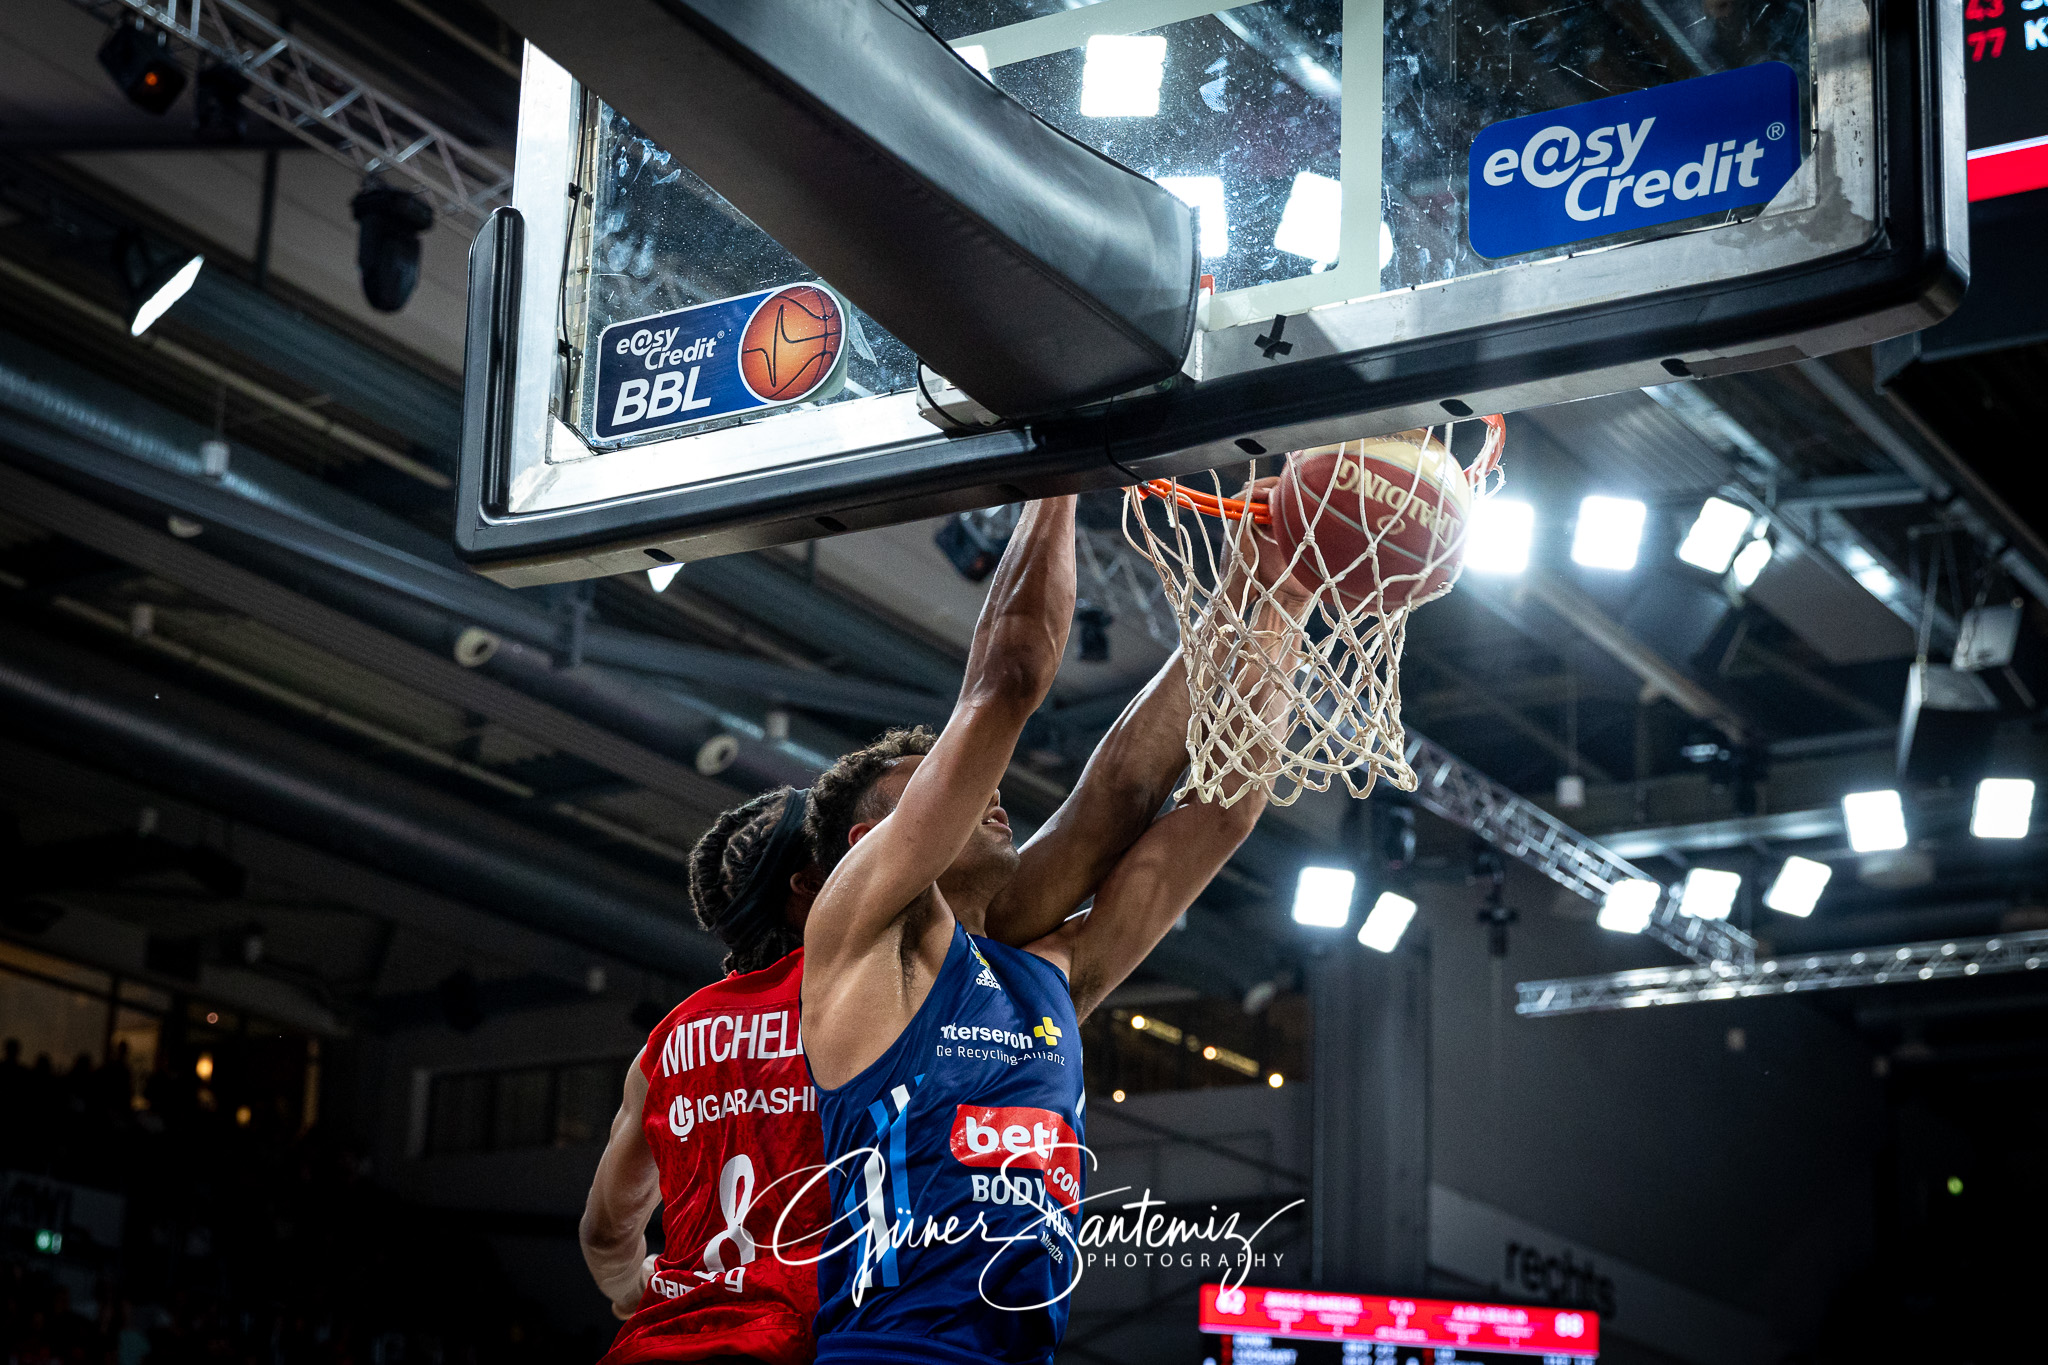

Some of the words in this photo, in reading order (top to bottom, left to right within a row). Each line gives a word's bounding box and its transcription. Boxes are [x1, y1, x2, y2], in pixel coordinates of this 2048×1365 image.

[1967, 26, 2007, 62] 77
[611, 366, 711, 427] BBL
[697, 1085, 816, 1124] IGARASHI
